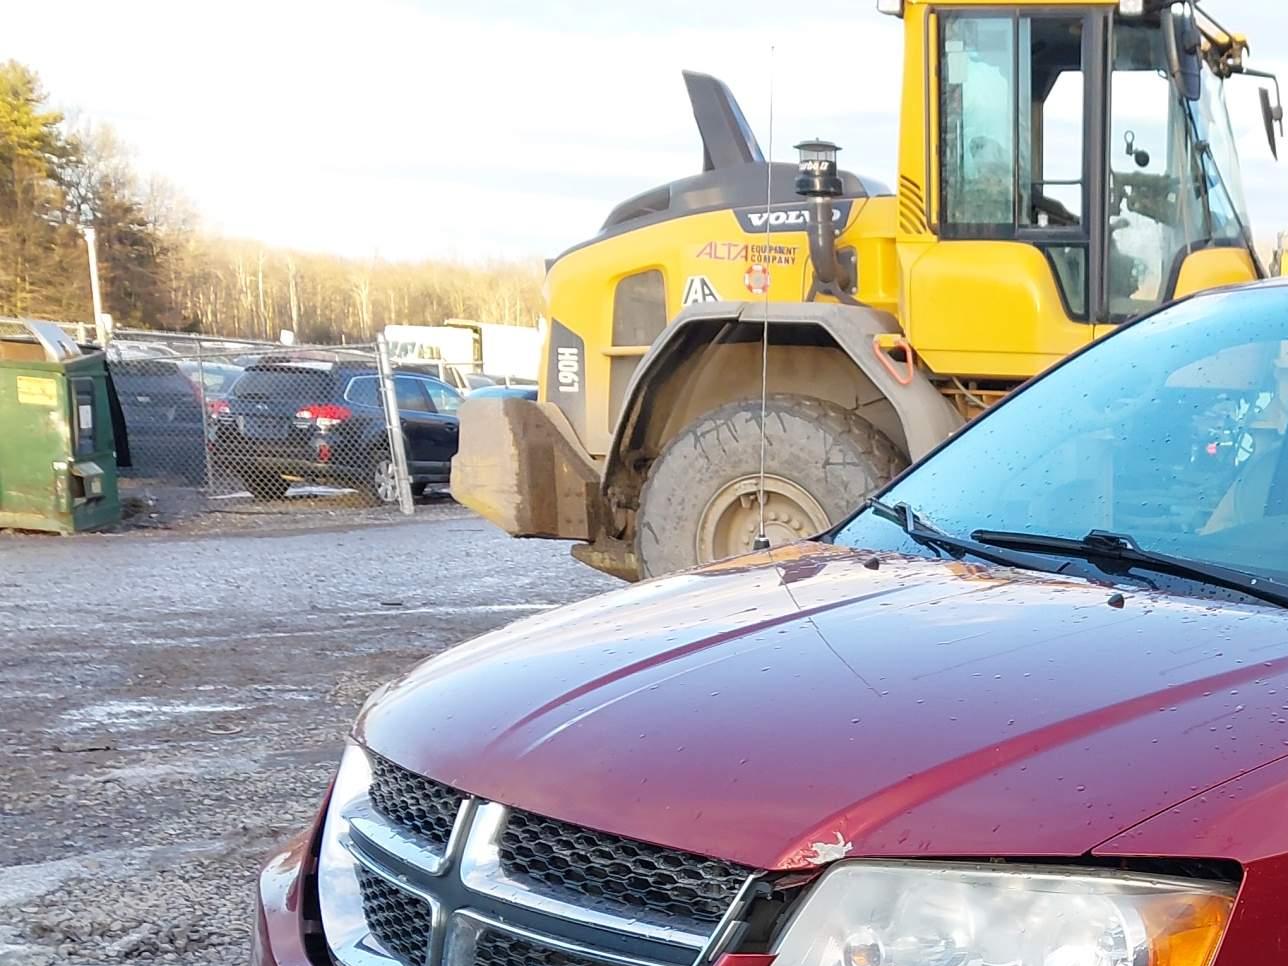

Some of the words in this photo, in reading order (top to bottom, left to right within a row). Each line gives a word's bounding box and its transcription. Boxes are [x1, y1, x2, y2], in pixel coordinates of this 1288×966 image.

[696, 241, 749, 262] ALTA
[751, 244, 797, 256] EQUIPMENT
[750, 254, 796, 264] COMPANY
[557, 347, 579, 392] L90H
